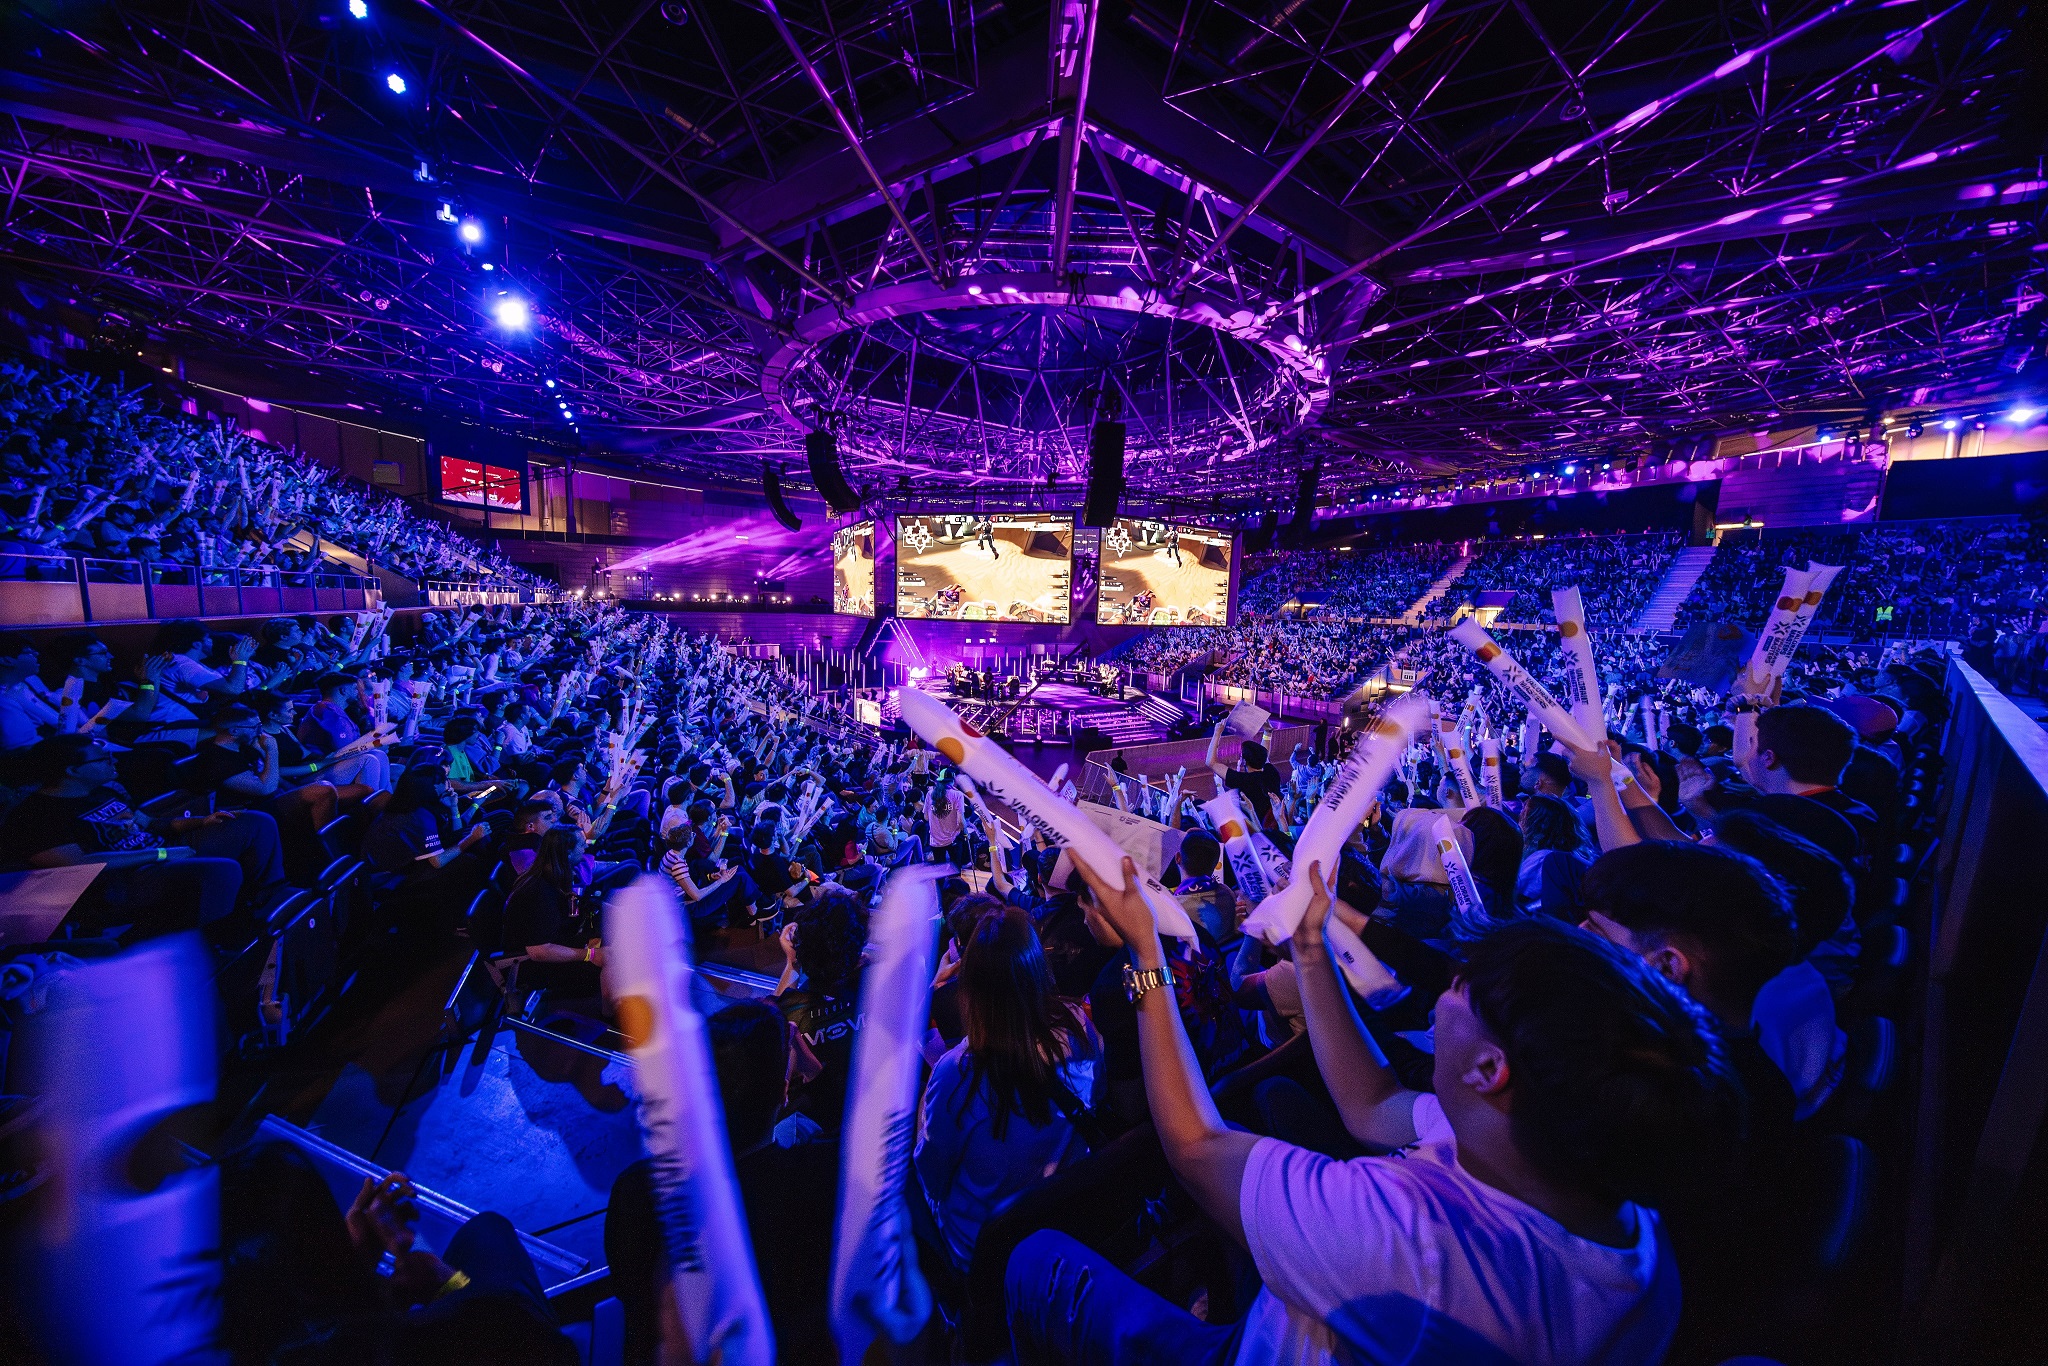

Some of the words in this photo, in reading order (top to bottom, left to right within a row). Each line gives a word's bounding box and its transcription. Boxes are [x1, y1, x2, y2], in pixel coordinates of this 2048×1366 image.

[1519, 680, 1549, 709] MASTERS
[1525, 676, 1557, 708] VALORANT
[1009, 797, 1071, 846] VALORANT
